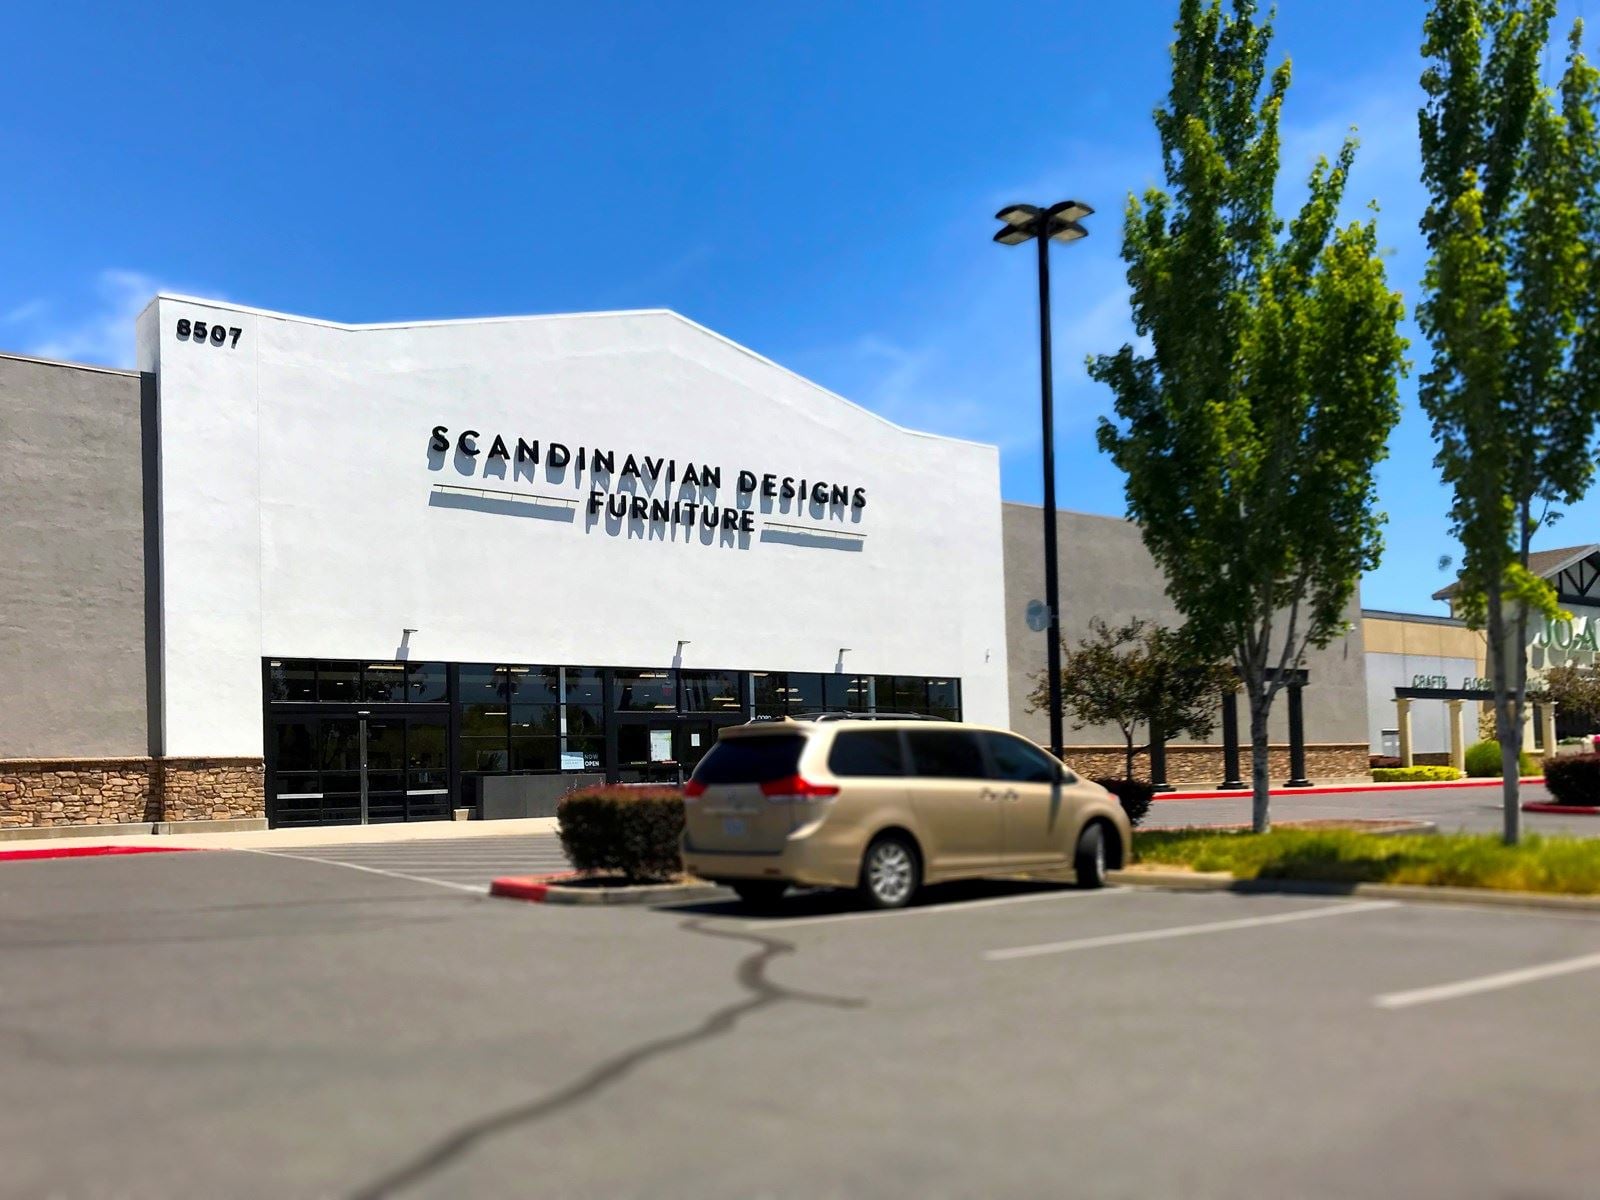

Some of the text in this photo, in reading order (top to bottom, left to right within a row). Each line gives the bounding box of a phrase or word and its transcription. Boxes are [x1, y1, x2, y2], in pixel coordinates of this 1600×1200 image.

[176, 318, 243, 348] 8507
[431, 425, 867, 509] SCANDINAVIAN DESIGNS
[588, 490, 755, 533] FURNITURE
